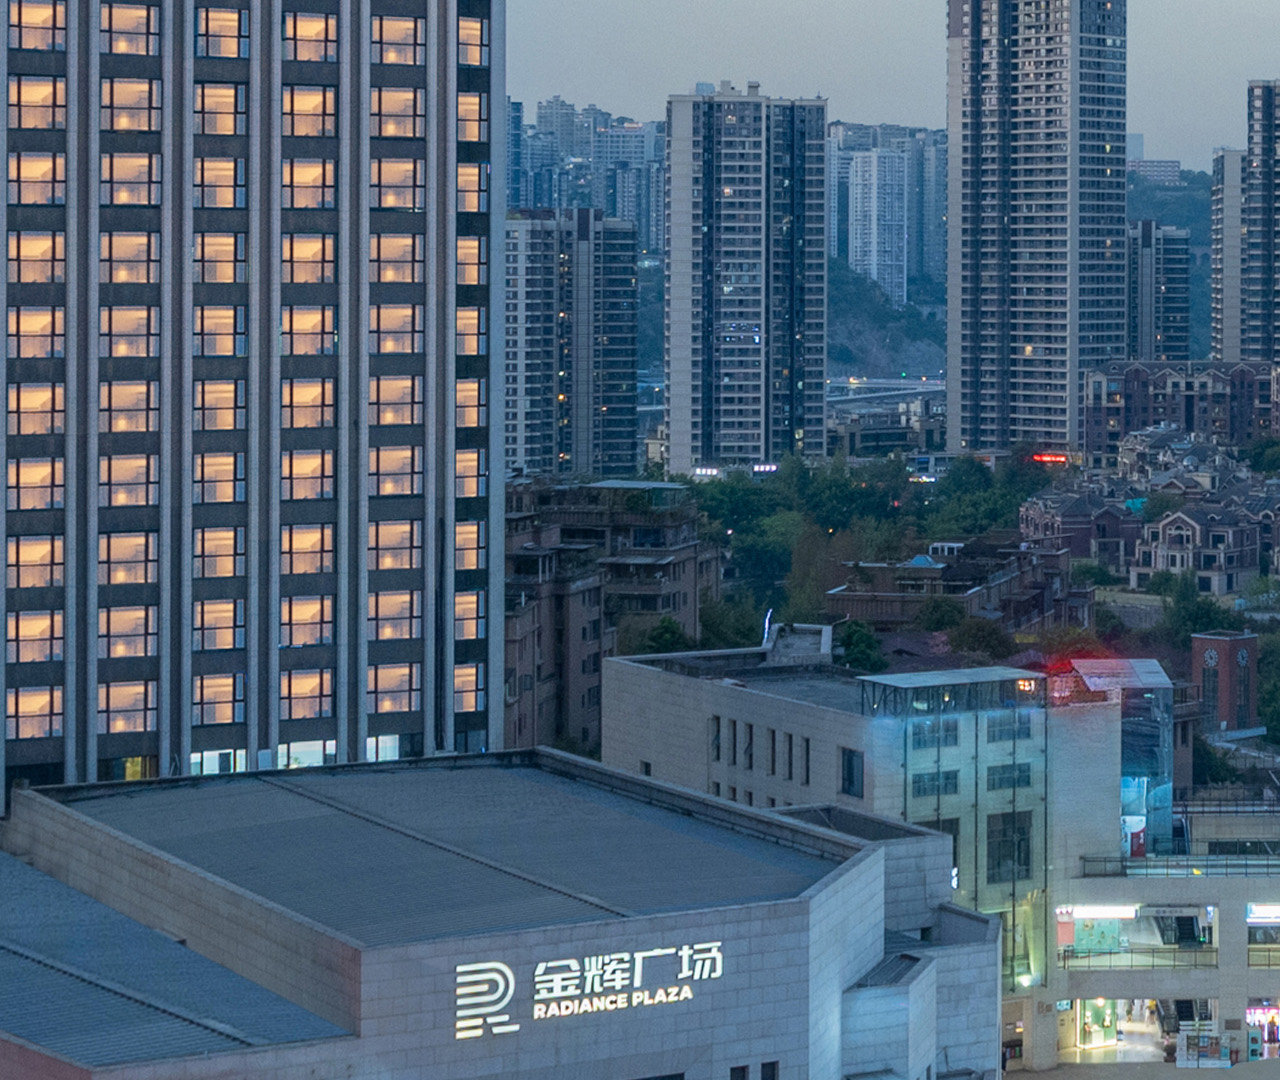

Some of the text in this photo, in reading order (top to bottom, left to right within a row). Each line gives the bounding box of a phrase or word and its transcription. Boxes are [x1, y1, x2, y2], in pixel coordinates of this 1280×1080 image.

[534, 941, 723, 1000] 金辉广场
[533, 984, 694, 1020] RADIANCE PLAZA
